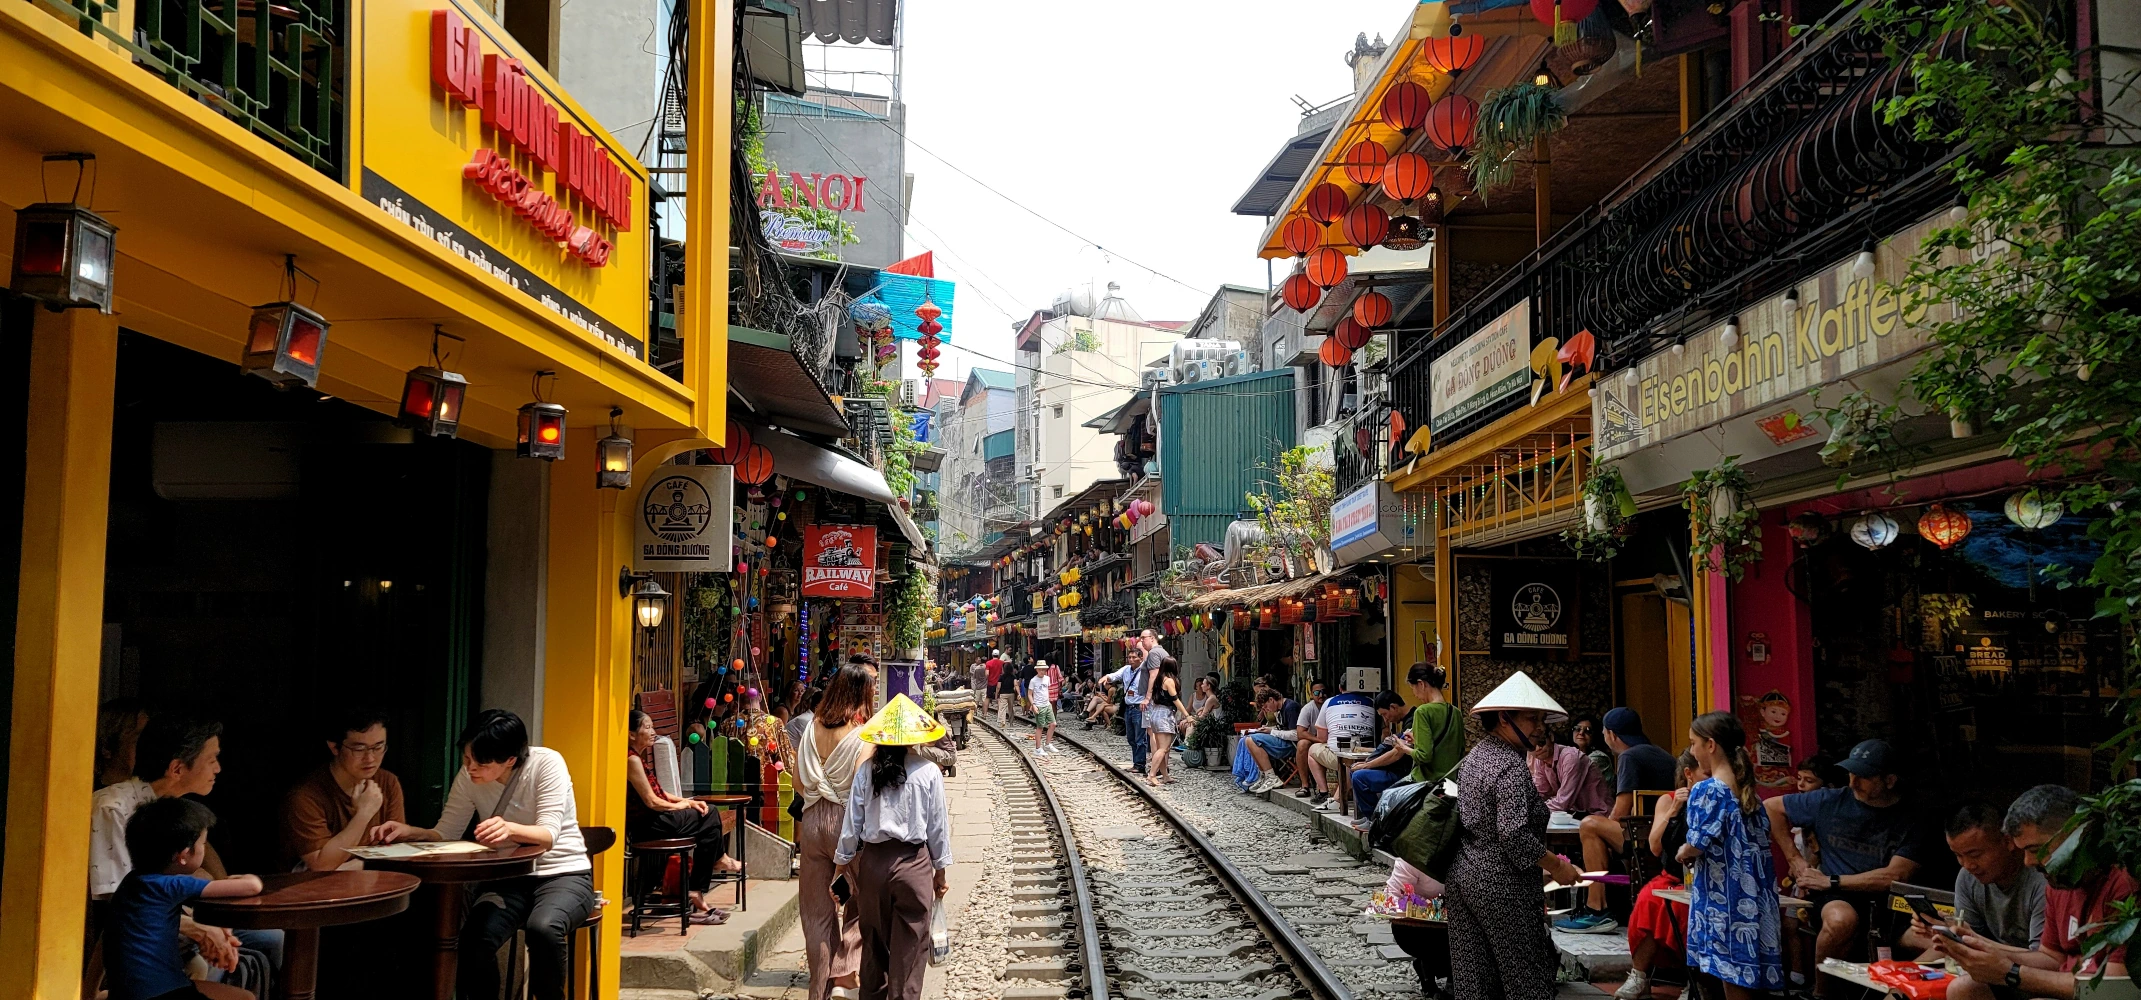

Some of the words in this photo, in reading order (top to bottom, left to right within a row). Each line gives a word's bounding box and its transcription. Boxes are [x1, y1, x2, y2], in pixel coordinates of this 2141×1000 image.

[431, 10, 483, 110] GA
[748, 168, 867, 213] ANOI
[760, 211, 832, 242] Premium
[1640, 331, 1785, 428] Eisenbahn
[1795, 270, 1930, 368] Kaffee
[1445, 376, 1457, 398] GA
[666, 481, 689, 490] CAFÉ
[643, 544, 655, 555] GA
[805, 568, 872, 584] RAILWAY
[829, 582, 849, 591] Café
[1984, 610, 2026, 619] BAKERY
[1503, 632, 1515, 644] GA
[1969, 651, 2006, 659] BREAD
